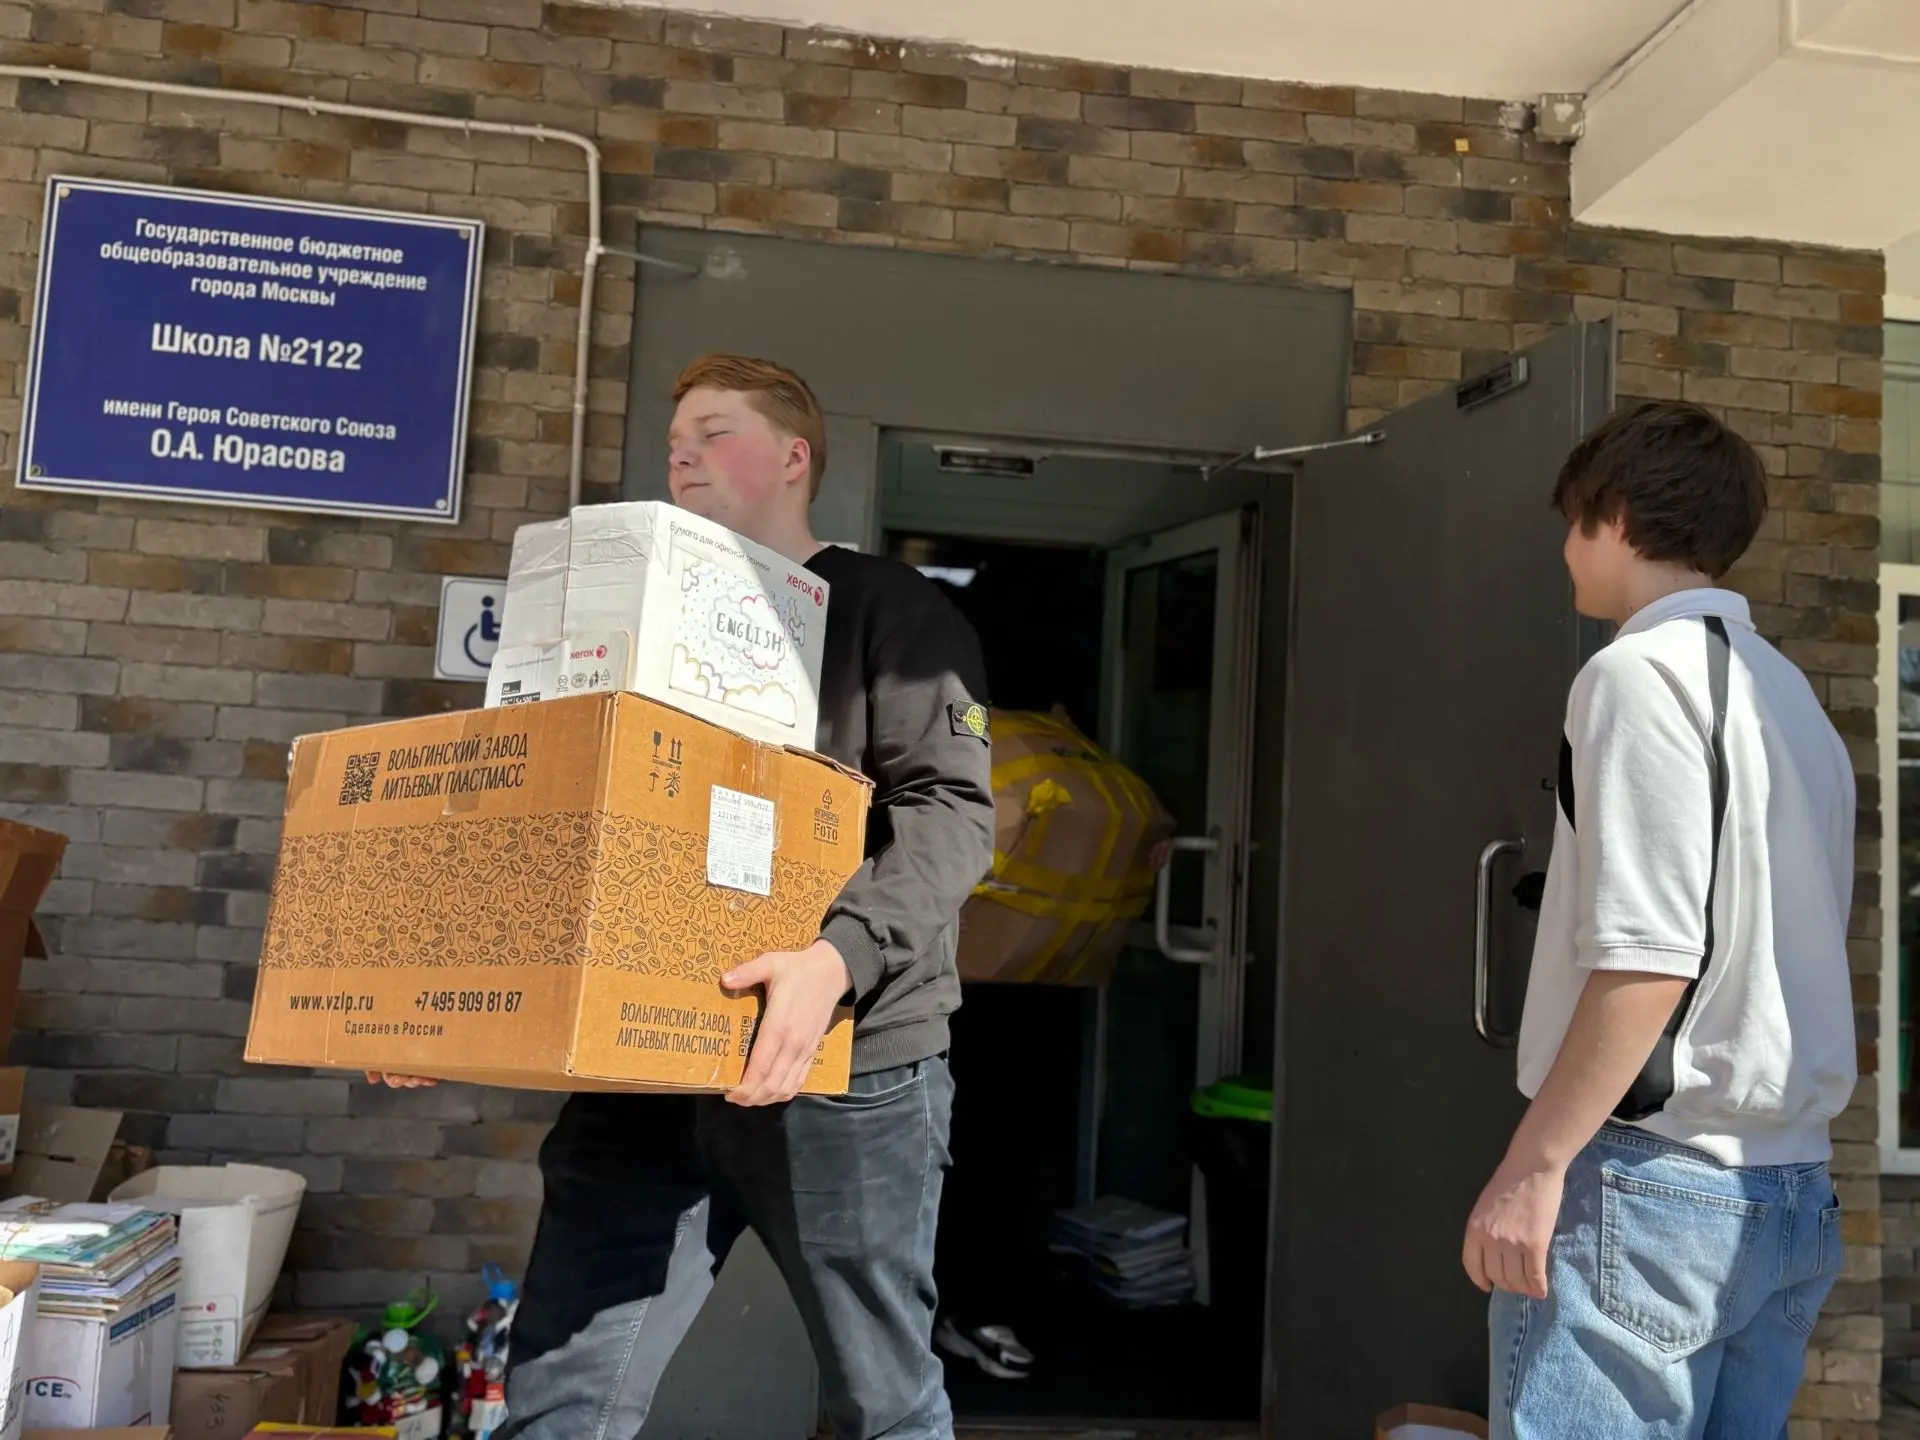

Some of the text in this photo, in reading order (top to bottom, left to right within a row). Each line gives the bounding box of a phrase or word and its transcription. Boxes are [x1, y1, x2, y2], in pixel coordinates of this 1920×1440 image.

[135, 218, 404, 265] Государственное бюджетное
[100, 242, 428, 292] общеобразовательное учреждение
[191, 278, 336, 307] города Москвы
[151, 322, 364, 370] Школа №2122
[103, 398, 397, 440] имени Героя Советского Союза
[150, 428, 346, 473] О.А. Юрасова
[670, 521, 699, 541] Бумага
[699, 535, 713, 547] для
[786, 572, 814, 597] xerox
[716, 612, 784, 653] ENGLISH
[569, 648, 594, 660] xerox
[387, 733, 528, 771] ВОЛЬГИНСКИЙ ЗАВОД
[380, 763, 526, 801] ЛИТЬЕВЫХ ПЛАСТМАСС
[290, 991, 374, 1015] www.vzlp.ru
[414, 991, 522, 1012] +7 495 909 81 87
[620, 1001, 731, 1035] ВОЛЬГИНСКИЙ ЗАВОД
[344, 1020, 391, 1036] Сделано
[402, 1021, 443, 1036] России
[616, 1026, 731, 1058] ЛИТЬЕВЫХ ПЛАСТМАСС
